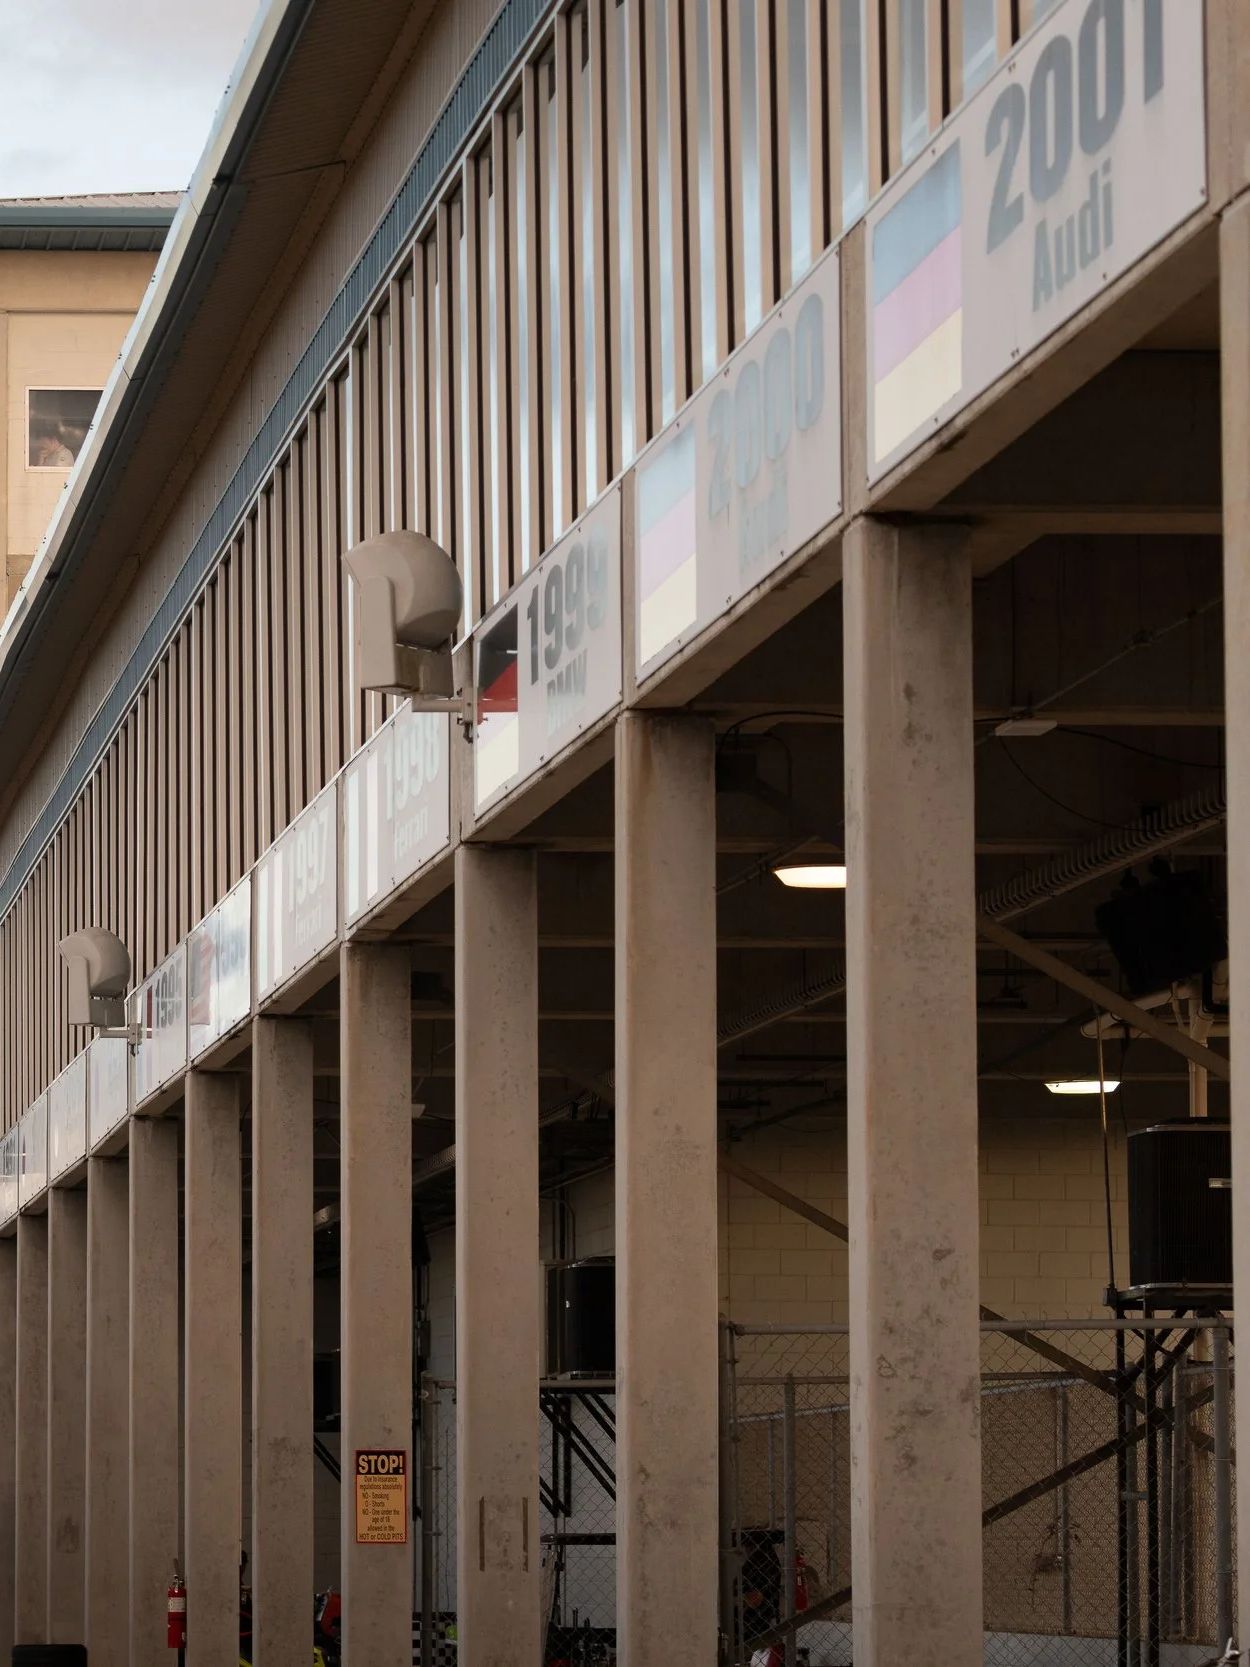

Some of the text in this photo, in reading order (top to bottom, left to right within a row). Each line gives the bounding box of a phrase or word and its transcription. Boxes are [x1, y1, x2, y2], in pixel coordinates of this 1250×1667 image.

[984, 0, 1165, 255] 2001
[1032, 156, 1114, 313] Audi
[707, 292, 826, 523] 2000
[526, 522, 610, 686] 1999
[383, 711, 441, 821] 1998
[287, 805, 330, 914] 1997
[358, 1454, 403, 1474] STOP!
[372, 1492, 390, 1500] Smoking
